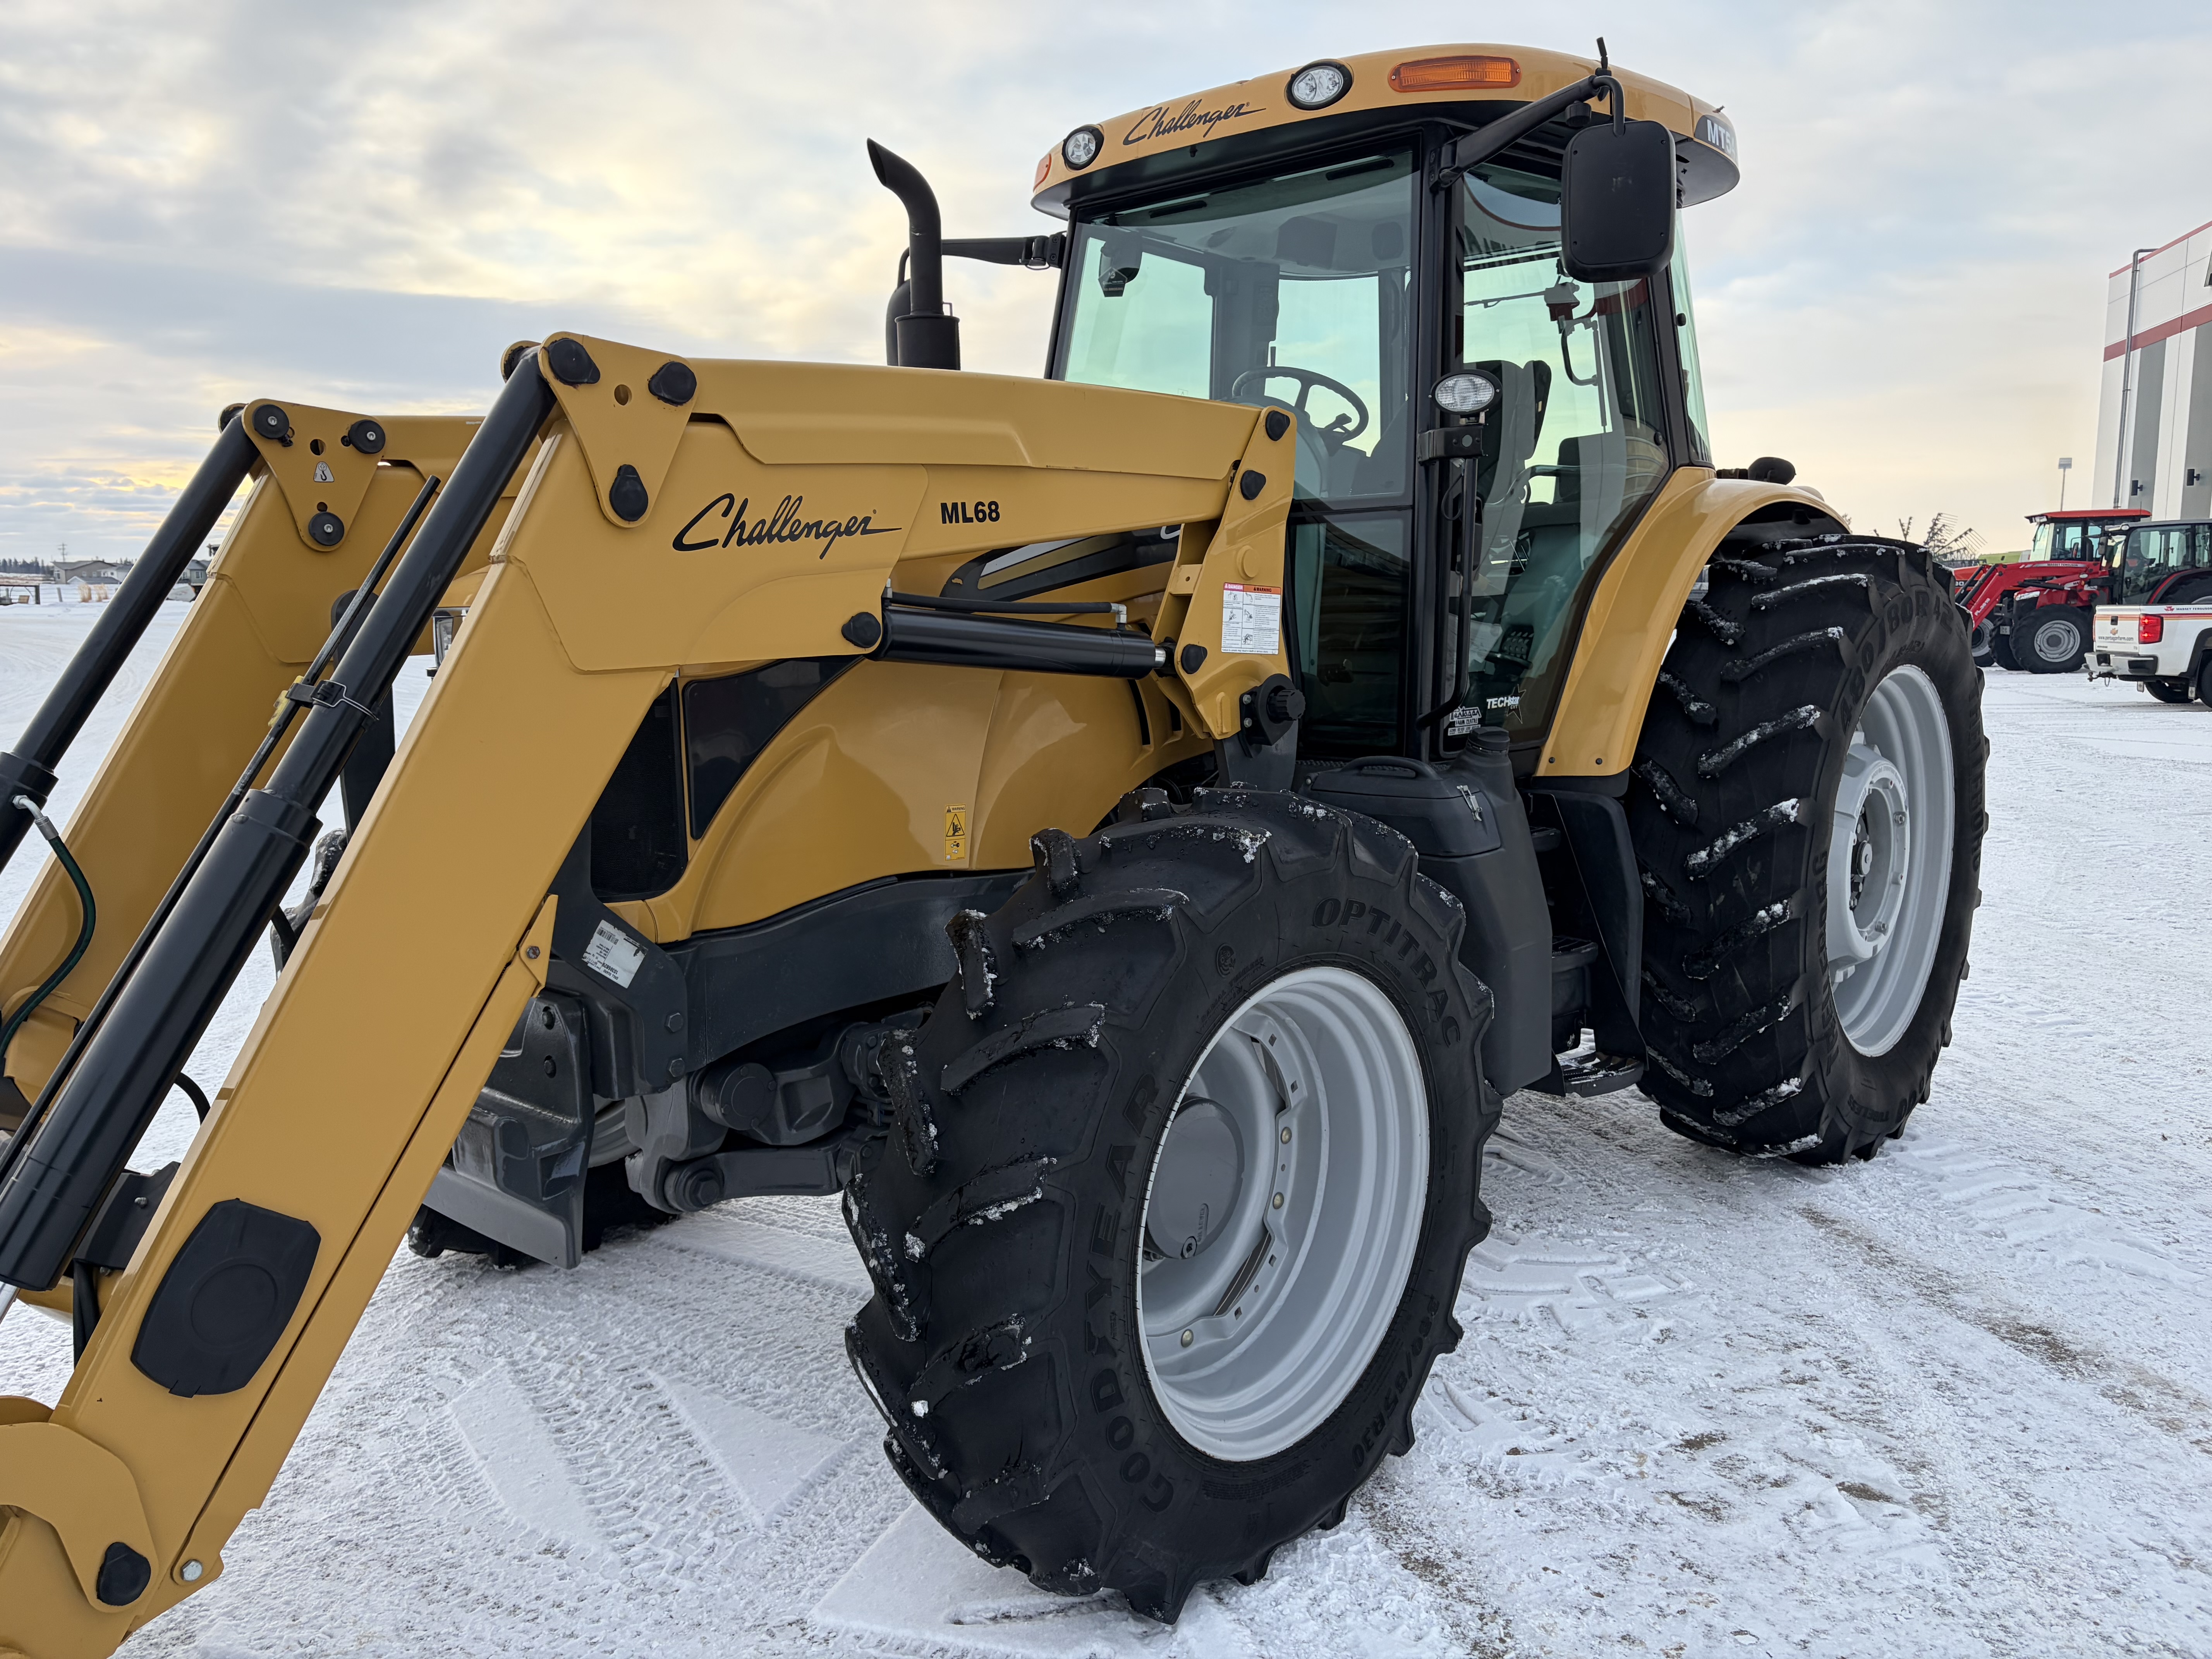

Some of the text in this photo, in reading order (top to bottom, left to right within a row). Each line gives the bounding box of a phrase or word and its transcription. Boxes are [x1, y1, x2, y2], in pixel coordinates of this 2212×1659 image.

[1123, 98, 1266, 146] Challenger
[672, 493, 902, 560] Challenger
[940, 500, 1001, 524] ML68
[1312, 897, 1460, 1048] OPTITRAC
